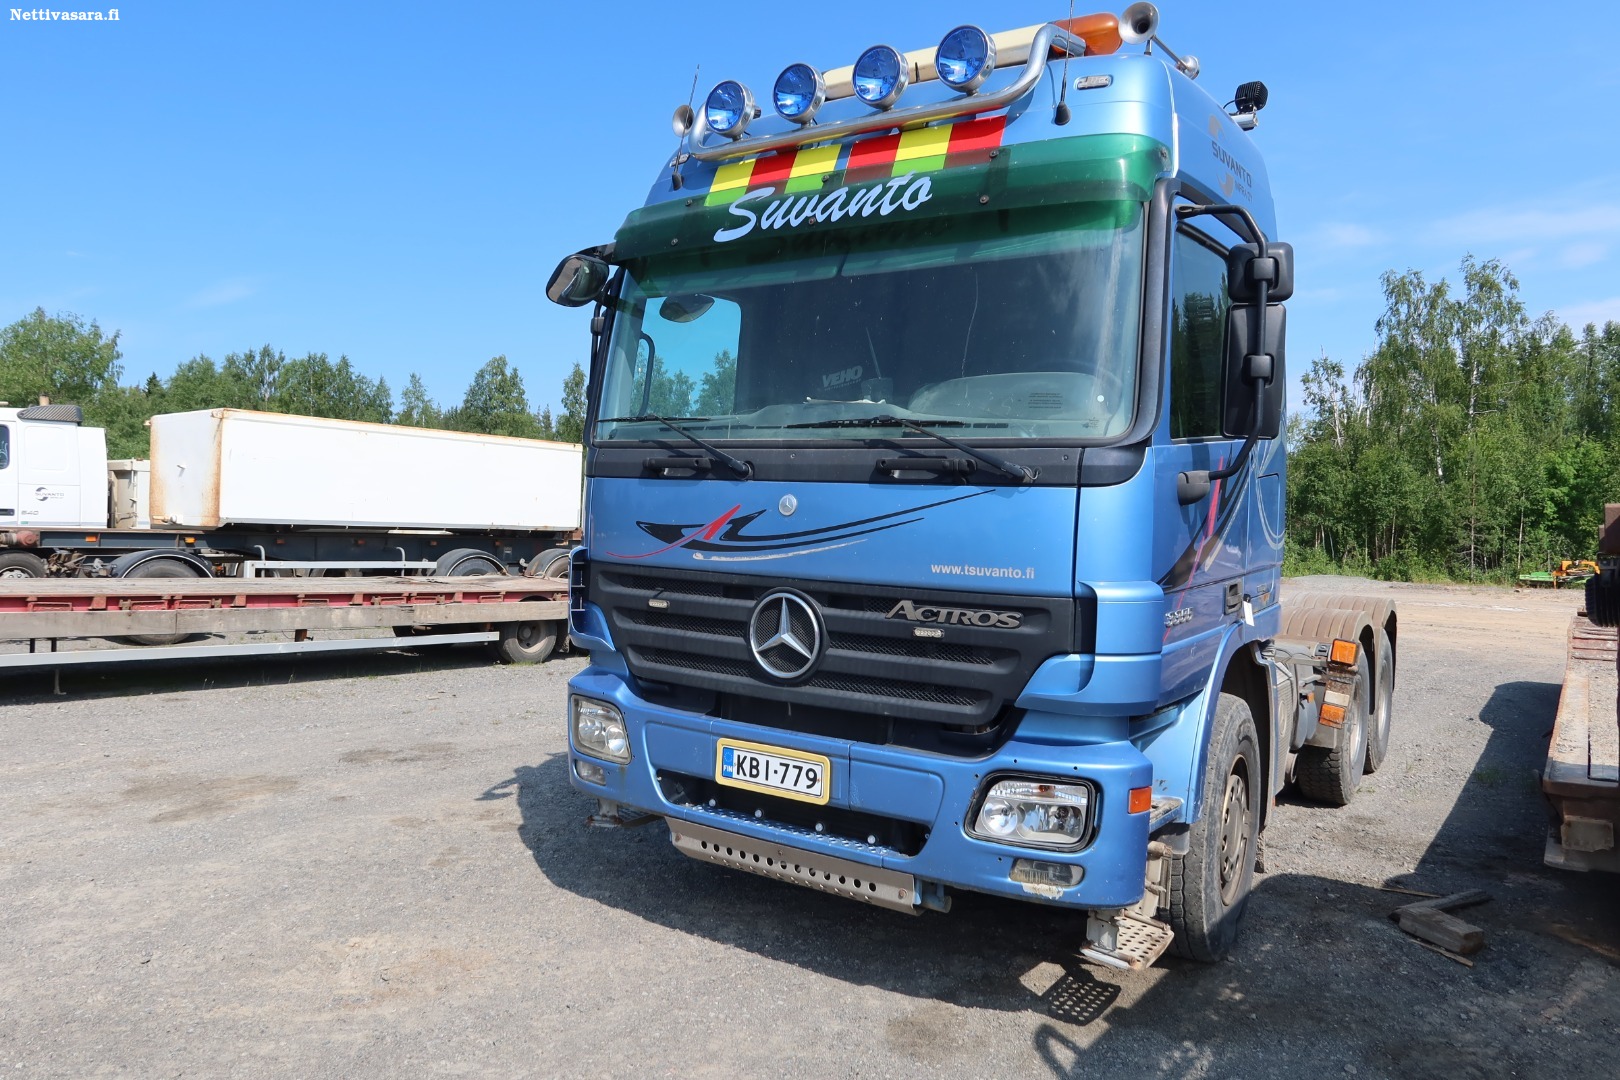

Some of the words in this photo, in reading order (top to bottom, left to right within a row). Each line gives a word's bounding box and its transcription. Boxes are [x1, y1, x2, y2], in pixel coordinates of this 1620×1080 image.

[1211, 140, 1252, 188] SUVANTO
[713, 170, 933, 243] Suvanto
[822, 365, 863, 388] VEHO
[931, 563, 1035, 579] www.tsuvanto.fi
[723, 764, 733, 773] FIN
[736, 754, 818, 790] KBI-779
